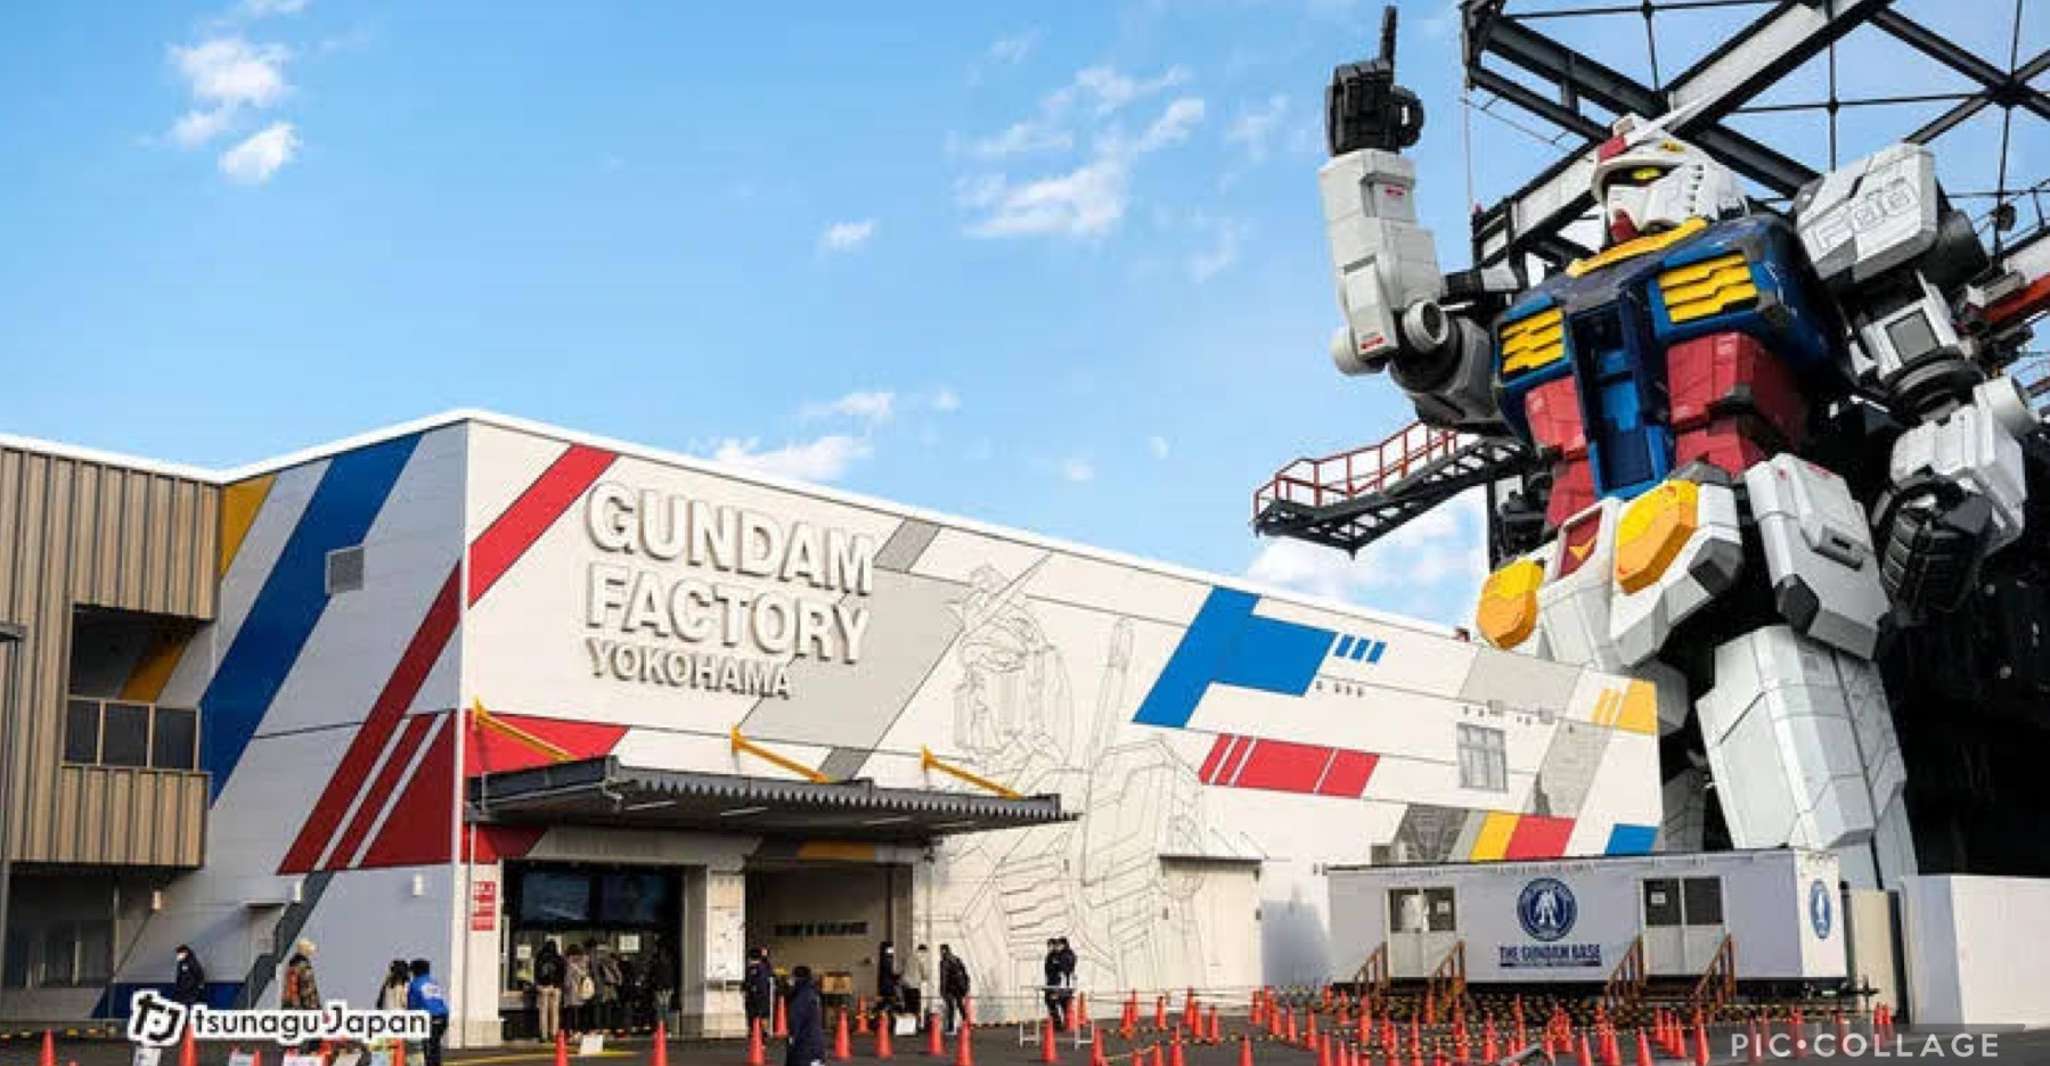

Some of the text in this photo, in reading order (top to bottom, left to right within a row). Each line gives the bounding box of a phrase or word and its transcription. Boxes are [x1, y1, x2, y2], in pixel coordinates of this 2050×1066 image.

[586, 481, 873, 596] GUNDAM
[586, 562, 870, 664] FACTORY
[585, 636, 791, 700] YOKOHAMA
